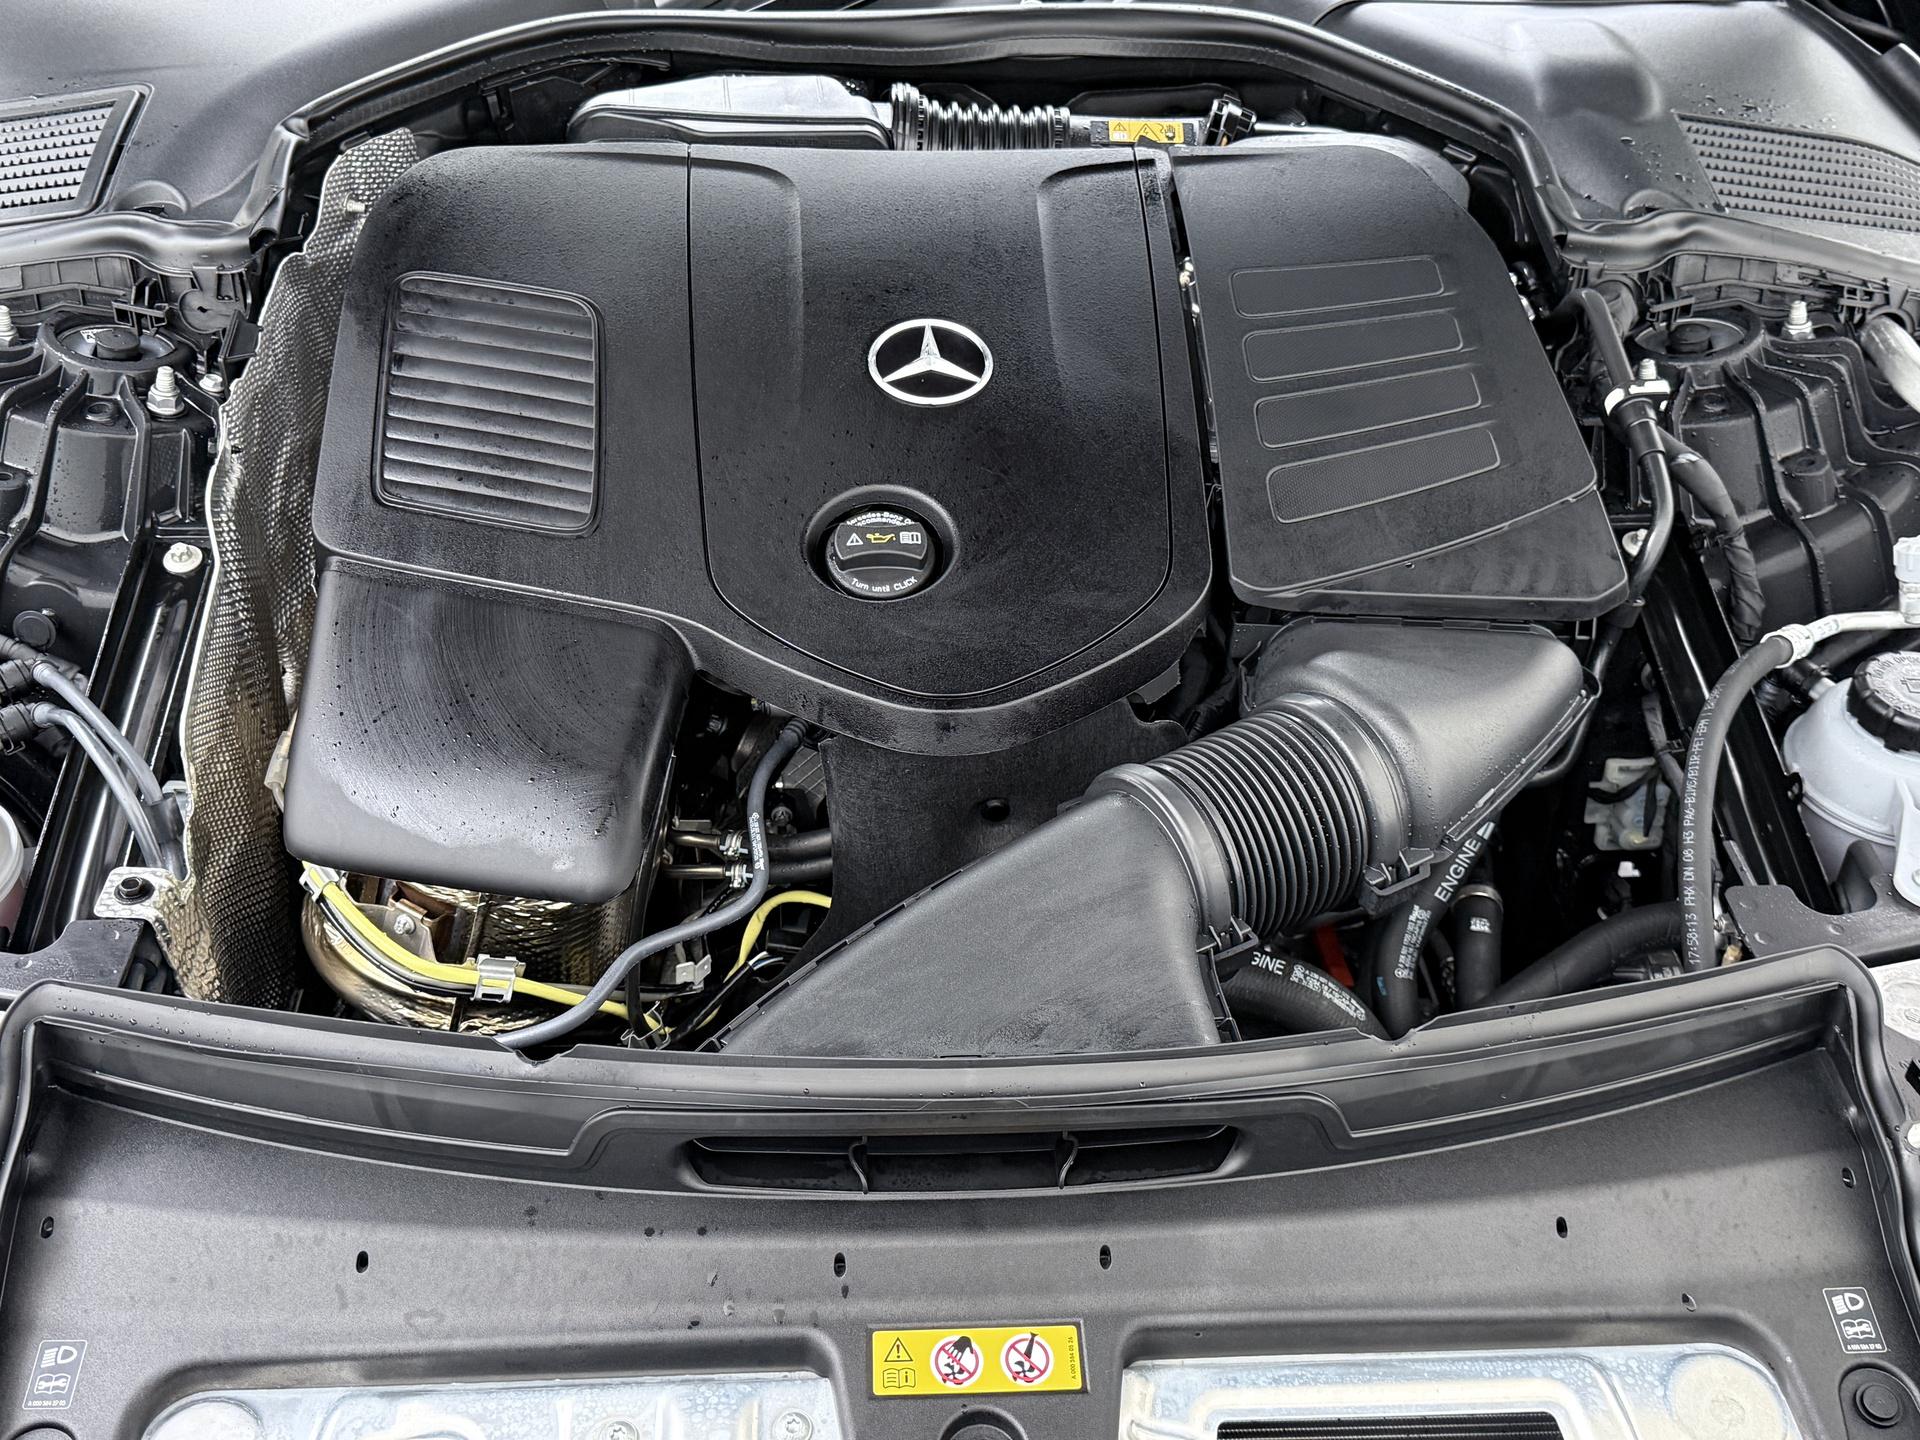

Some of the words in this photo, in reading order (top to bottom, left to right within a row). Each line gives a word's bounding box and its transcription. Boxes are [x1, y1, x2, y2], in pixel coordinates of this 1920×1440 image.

[851, 577, 869, 591] Turn
[871, 585, 891, 593] until
[893, 576, 918, 591] CLICK
[1434, 837, 1482, 902] ENGINE
[1685, 912, 1701, 965] 17:58:13
[1251, 951, 1286, 976] GINE
